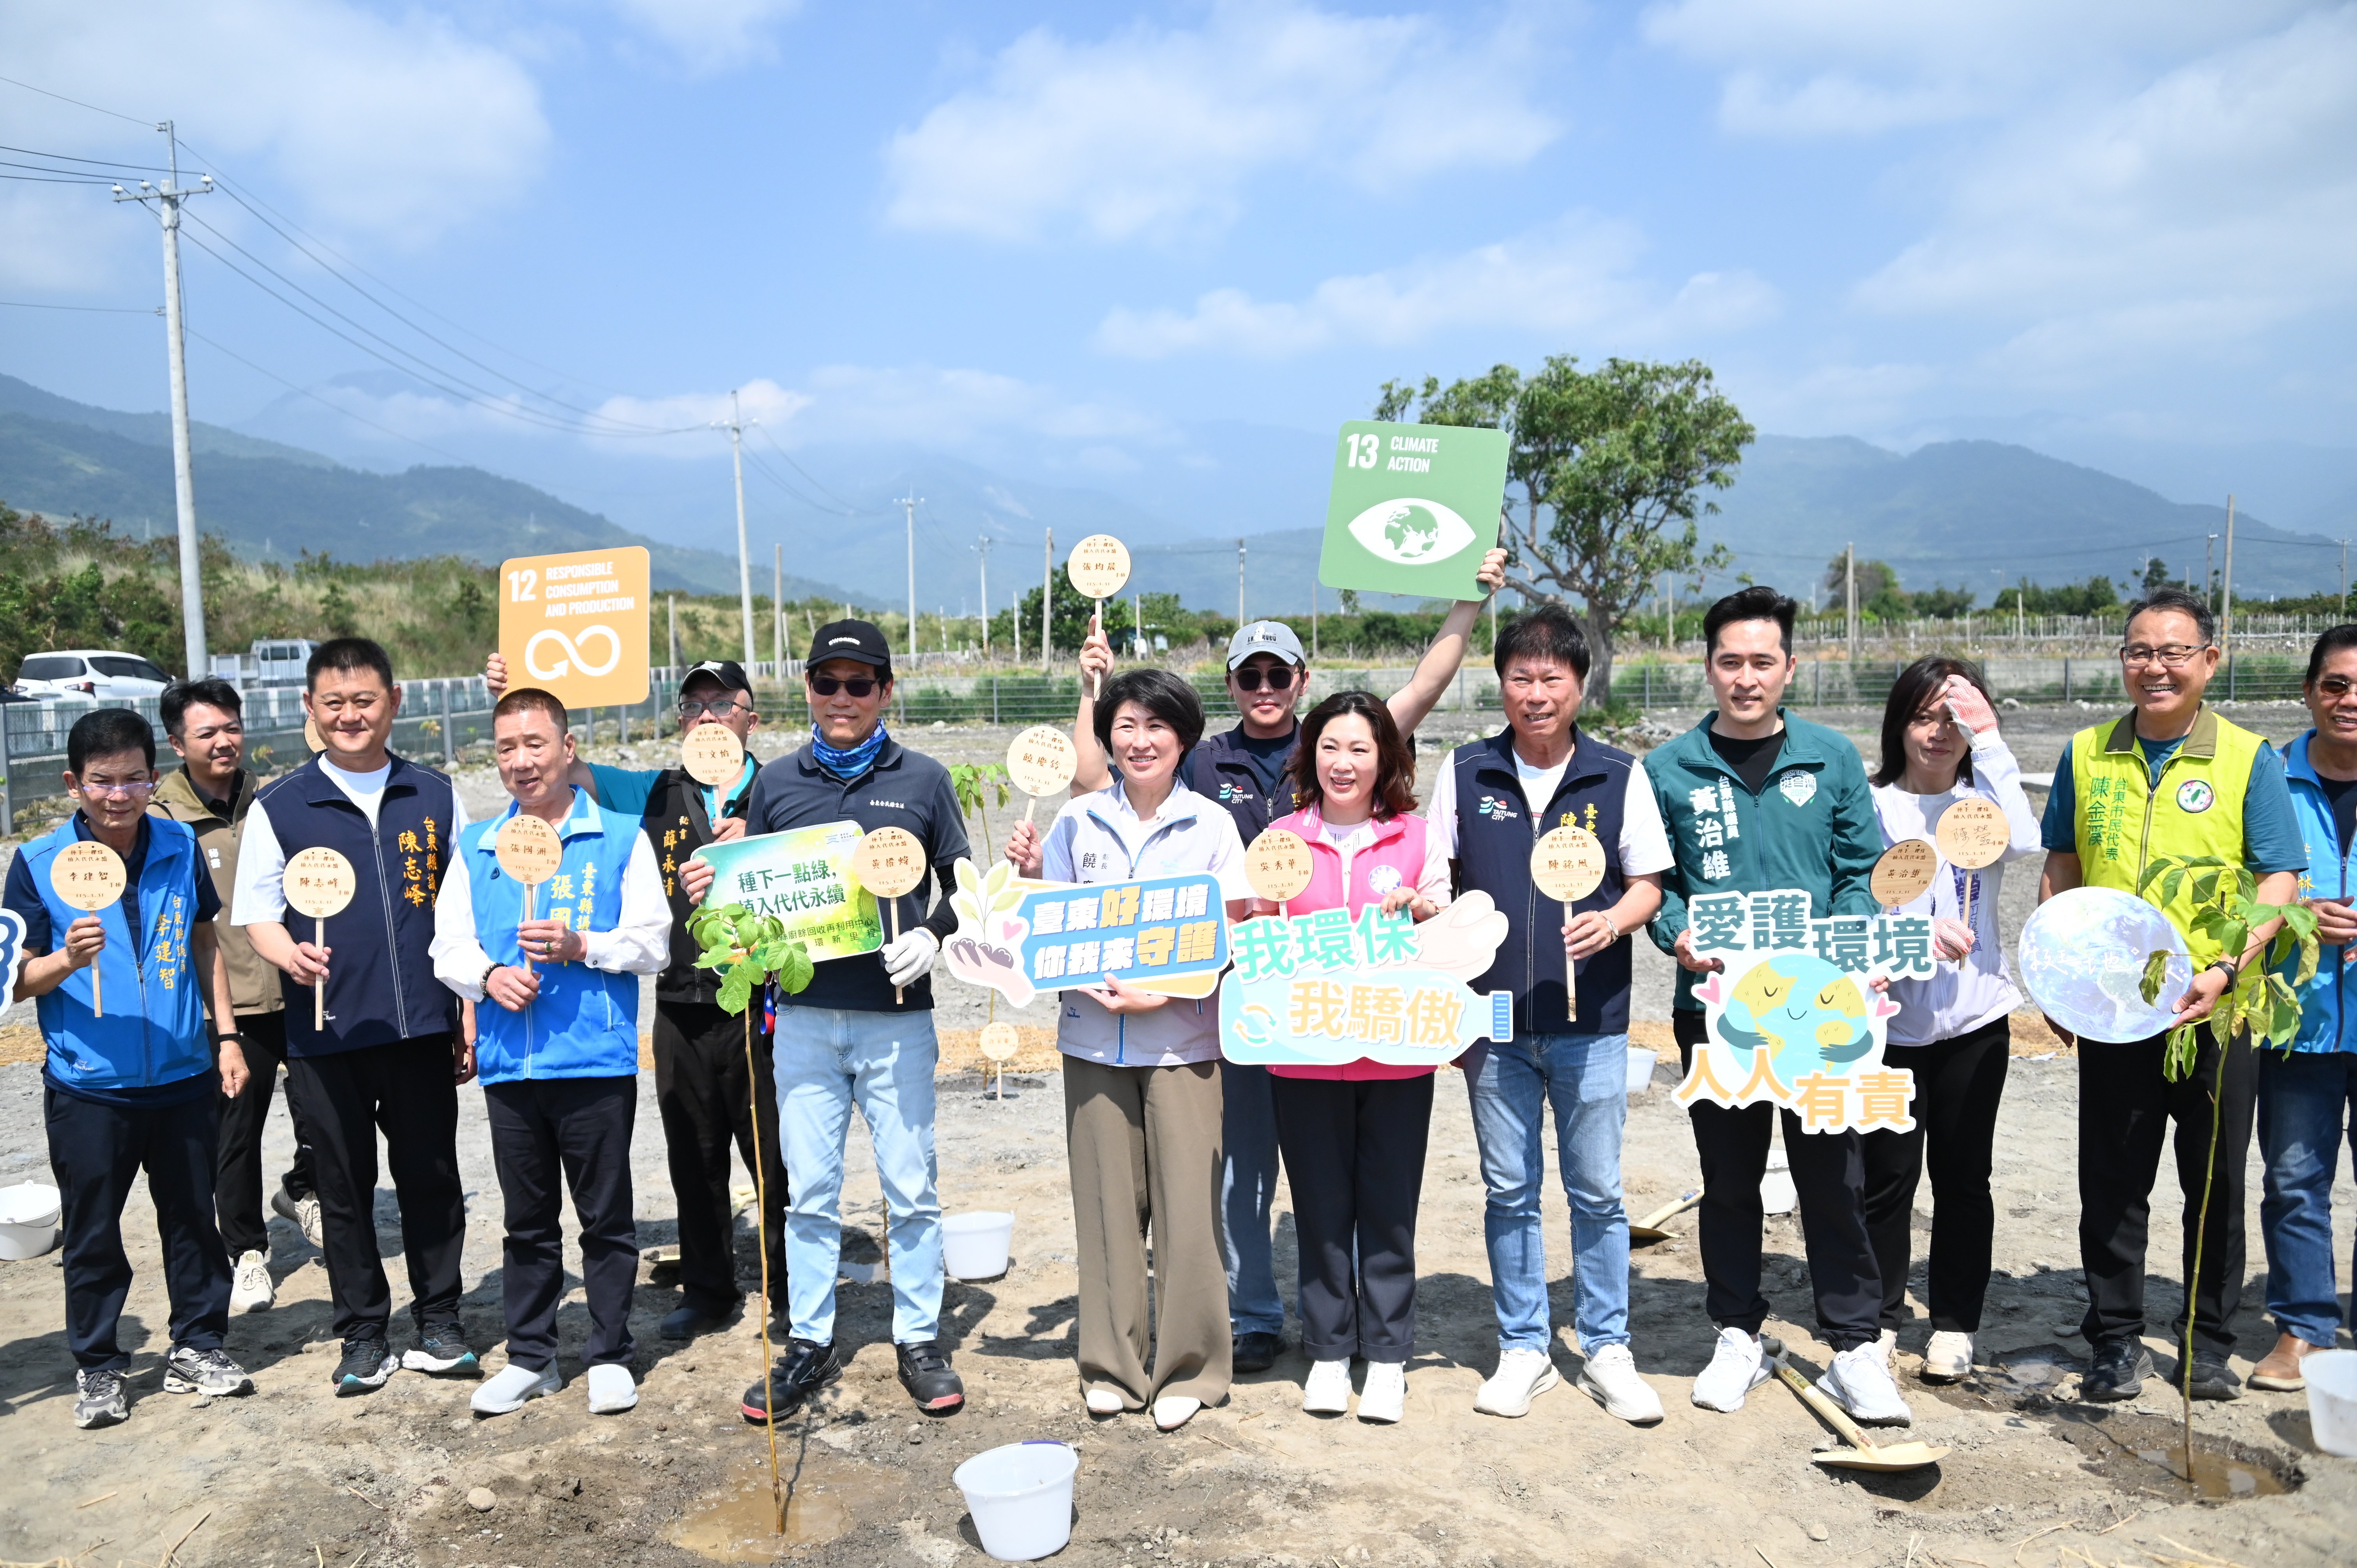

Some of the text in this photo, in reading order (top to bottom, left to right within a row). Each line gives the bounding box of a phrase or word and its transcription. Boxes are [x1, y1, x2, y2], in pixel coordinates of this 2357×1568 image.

[1347, 433, 1439, 468] 13 CLIMATE
[1387, 456, 1430, 472] ACTION
[508, 562, 613, 602] 12 RESPONSIBLE
[546, 579, 618, 599] CONSUMPTION
[545, 597, 634, 617] AND PRODUCTION
[697, 749, 729, 759] 王文怡
[1493, 809, 1518, 818] TAITUNG
[1718, 775, 1740, 839] 台東縣議員
[2105, 777, 2127, 861] 台東市民代表
[678, 816, 689, 840] 秘書
[1689, 786, 1730, 880] 黃治維
[510, 844, 546, 856] 張國洲
[663, 830, 677, 897] 薛永清
[1260, 858, 1297, 872] 吳秀華
[1548, 859, 1588, 870] 陳銘風
[69, 871, 108, 881] 李建智
[300, 878, 338, 888] 陳志峰
[398, 830, 426, 907] 陳志峰
[1083, 853, 1097, 884] 饒
[1887, 869, 1920, 879] 黃治維
[2297, 875, 2315, 901] 林
[1032, 884, 1209, 935] 臺東好環境
[154, 914, 176, 989] 李建智
[172, 895, 186, 973] 台東縣議員
[1034, 920, 1217, 979] 你我來守護
[1233, 906, 1418, 979] 我環保
[1693, 894, 1932, 974] 愛護環境
[1290, 981, 1463, 1046] 我驕傲
[1676, 1049, 1911, 1127] 人人有責
